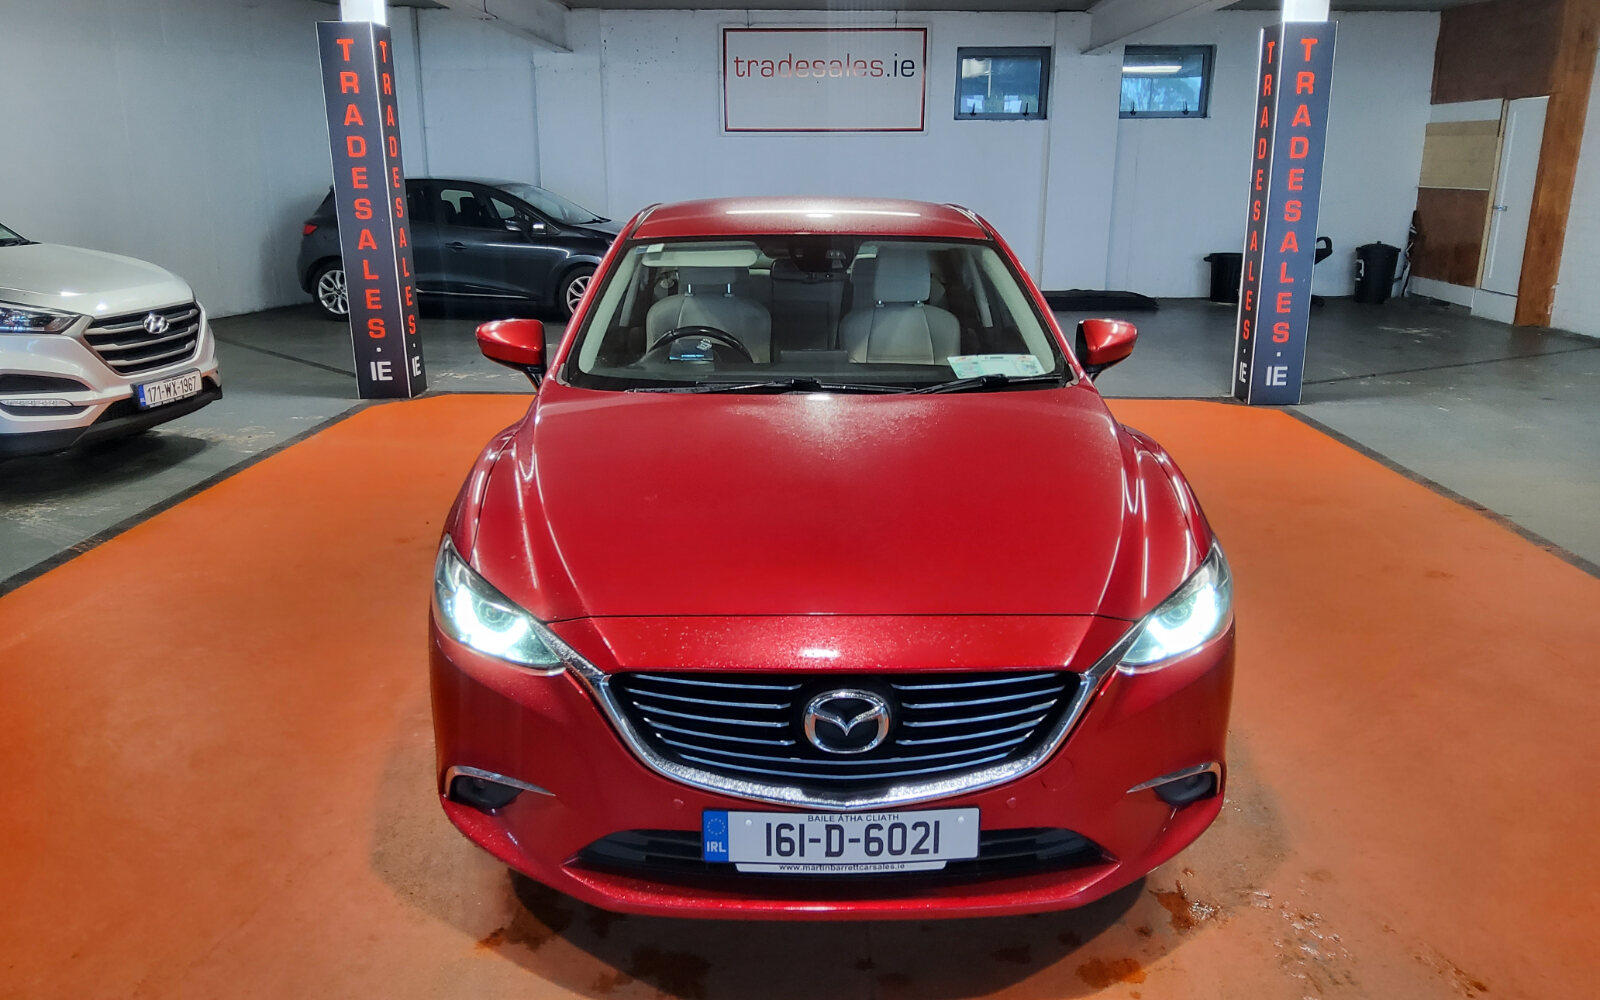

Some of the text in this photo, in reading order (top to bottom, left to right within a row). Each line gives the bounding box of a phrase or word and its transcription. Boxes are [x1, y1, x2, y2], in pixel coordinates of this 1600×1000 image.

[733, 53, 916, 78] tradesales.ie
[147, 375, 197, 403] 171-WX-1967
[807, 814, 835, 822] BAILE
[865, 813, 900, 822] CLIATH
[706, 841, 727, 854] IRL
[765, 820, 940, 858] 161-D-6021
